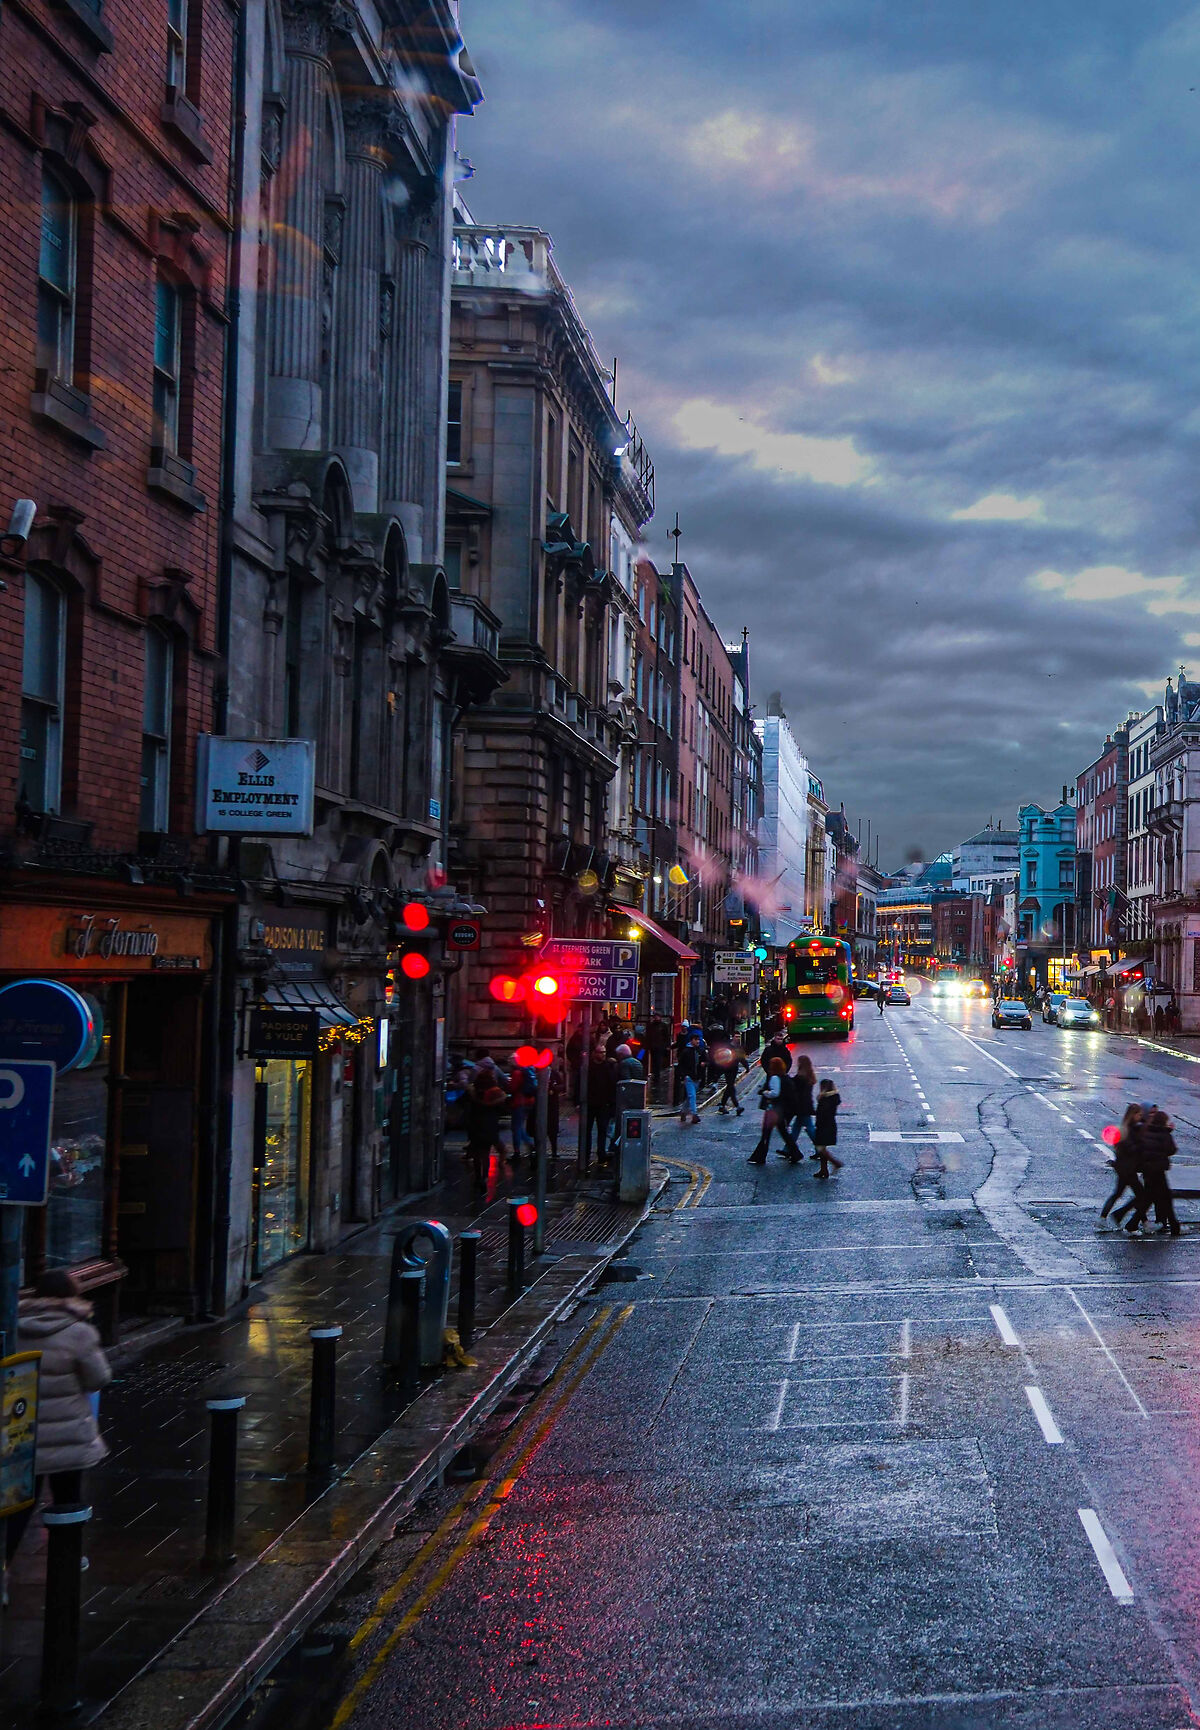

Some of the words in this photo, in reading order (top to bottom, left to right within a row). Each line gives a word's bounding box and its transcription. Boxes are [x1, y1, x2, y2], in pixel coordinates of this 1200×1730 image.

[238, 772, 275, 786] ELLIS
[212, 789, 299, 805] EMPLOYMENT
[306, 929, 324, 951] YULE
[562, 945, 590, 954] STEPHENS
[591, 946, 611, 955] GREEN
[579, 958, 602, 966] PARK
[579, 987, 606, 996] PARK
[615, 978, 629, 996] P
[275, 1033, 304, 1041] YULE
